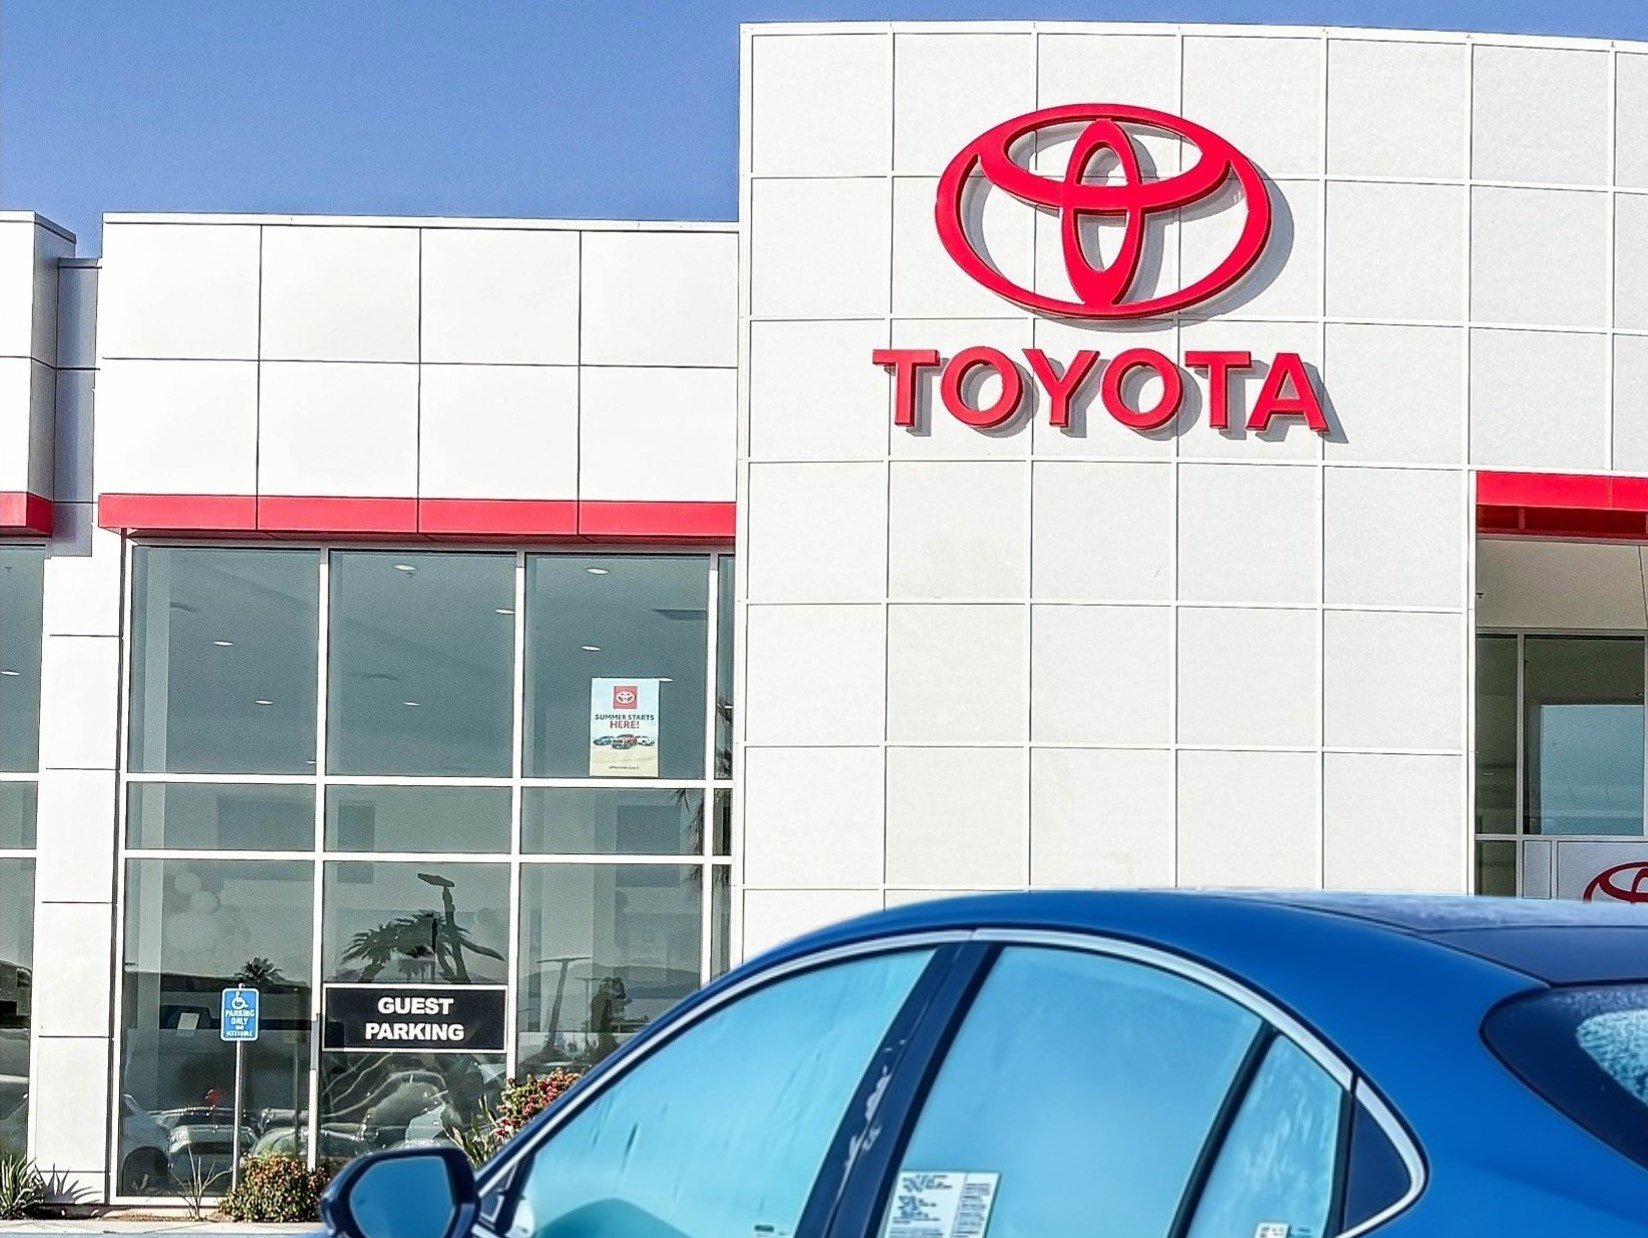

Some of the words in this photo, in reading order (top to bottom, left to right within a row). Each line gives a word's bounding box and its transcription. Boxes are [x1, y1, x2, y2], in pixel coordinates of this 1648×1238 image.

[872, 346, 1329, 432] TOYOTA
[610, 720, 640, 729] HERE!
[377, 997, 454, 1015] GUEST
[224, 1009, 255, 1018] PARKING
[230, 1016, 249, 1025] ONLY
[364, 1022, 465, 1041] PARKING
